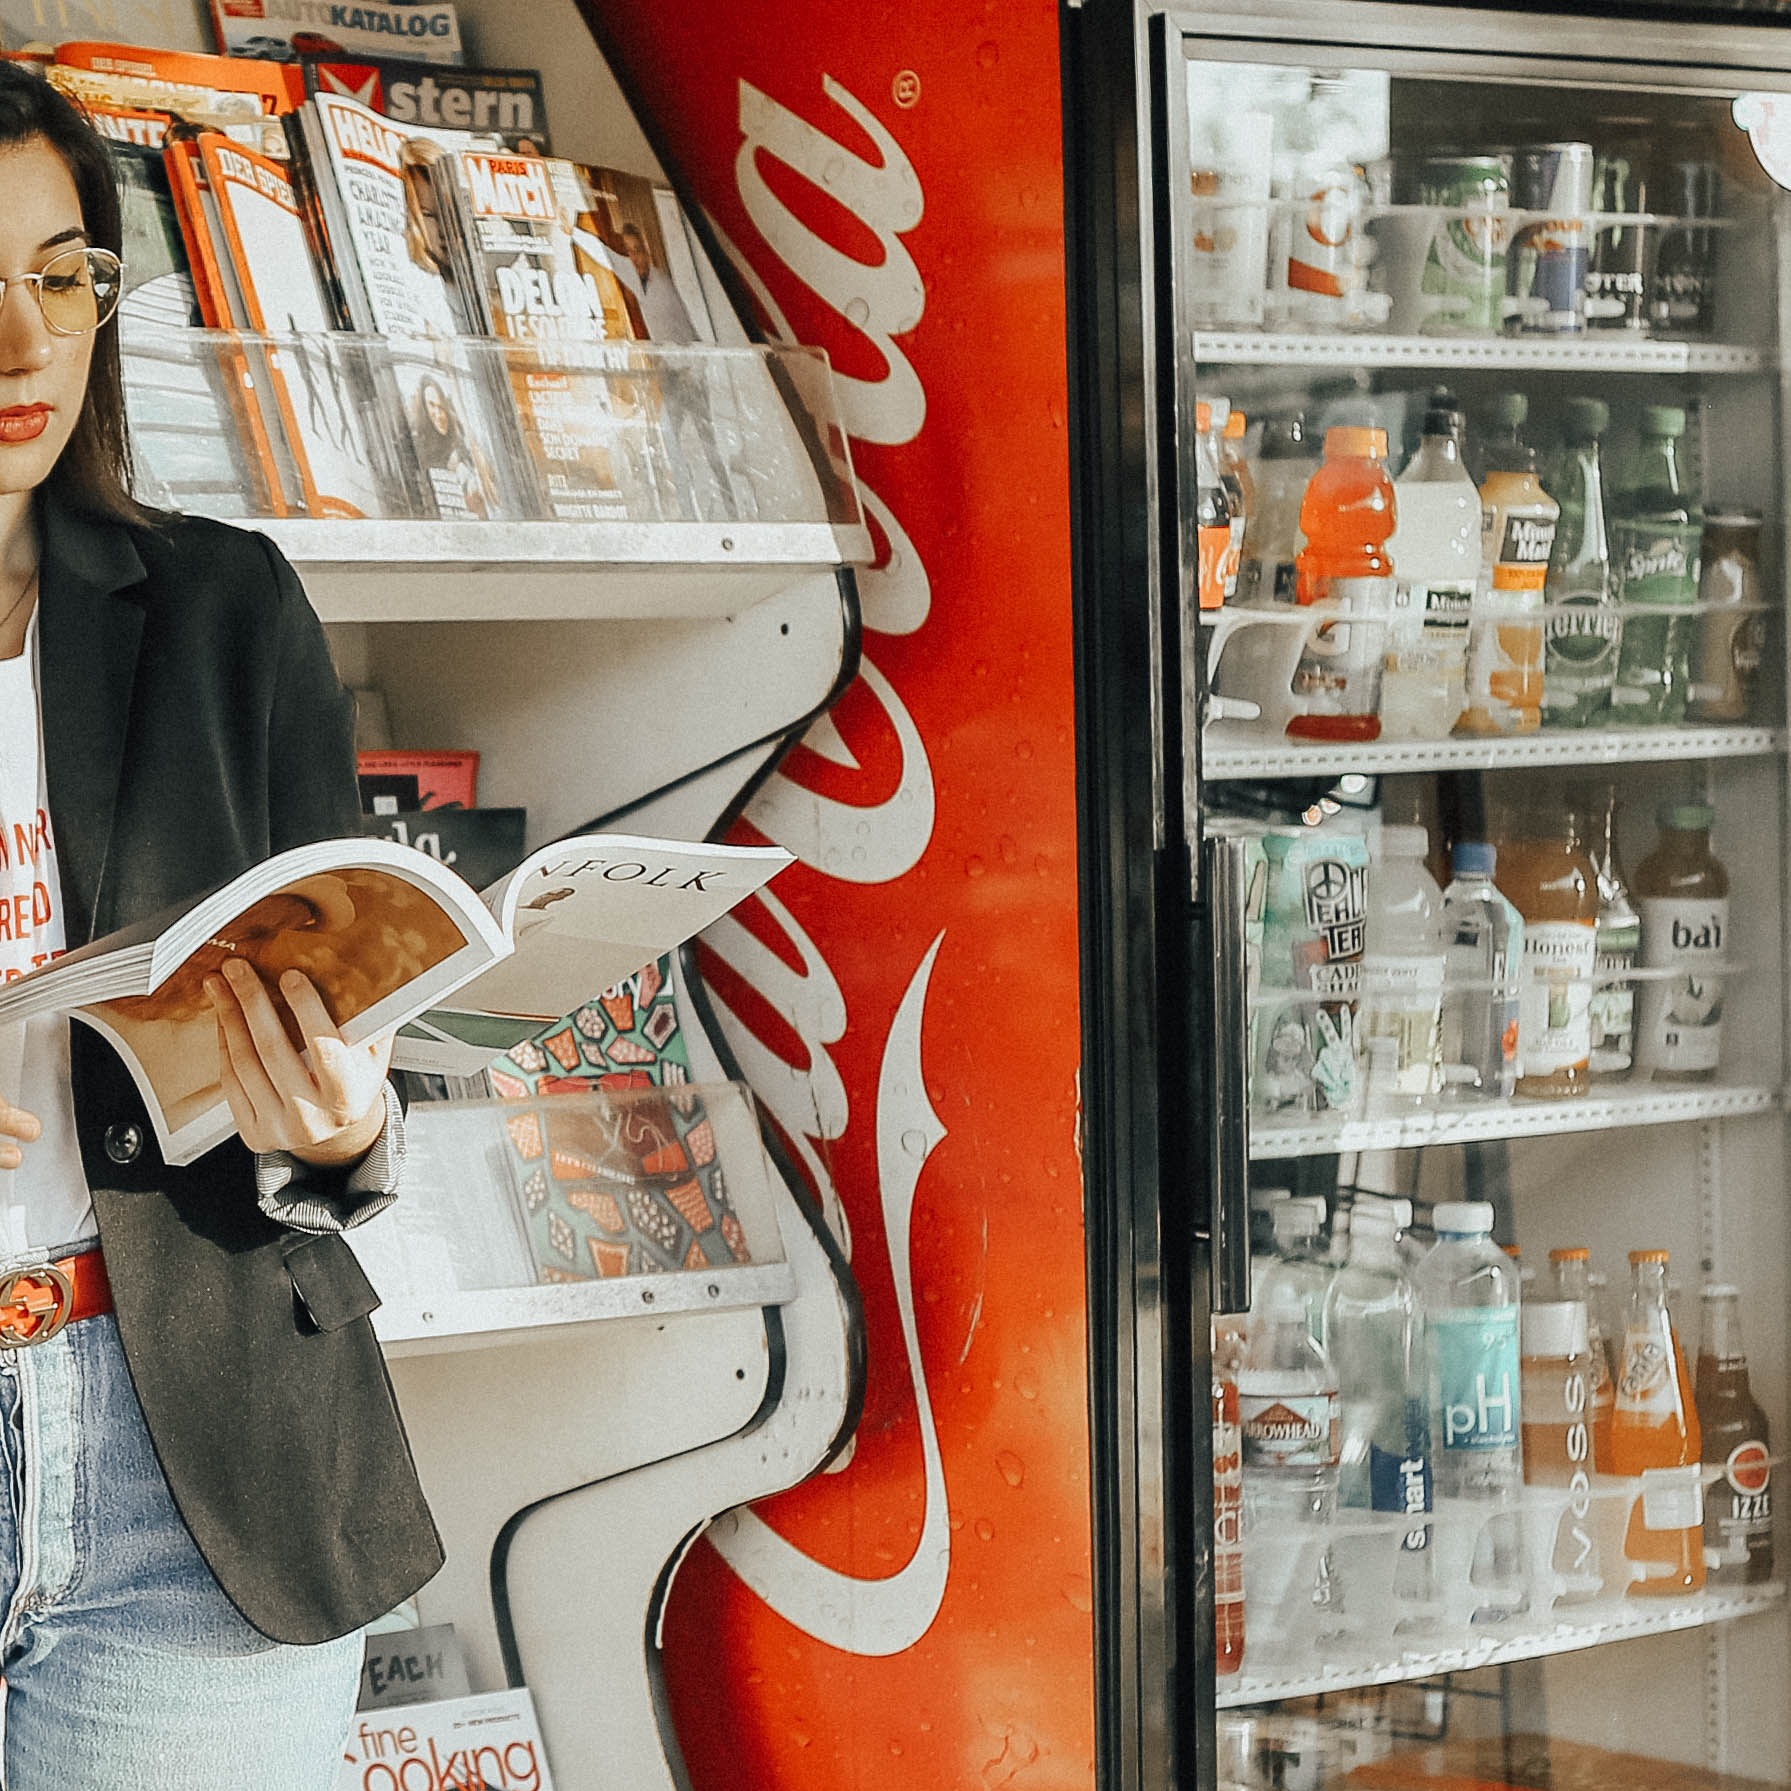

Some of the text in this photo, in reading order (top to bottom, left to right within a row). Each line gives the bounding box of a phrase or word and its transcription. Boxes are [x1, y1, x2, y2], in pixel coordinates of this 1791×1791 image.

[388, 77, 534, 130] stern
[217, 149, 256, 187] DER
[489, 159, 526, 175] PARIS
[469, 157, 552, 219] MATCH
[1524, 939, 1588, 954] Honest
[1672, 915, 1721, 948] bai
[1446, 1373, 1512, 1445] pH
[359, 1723, 417, 1759] fine
